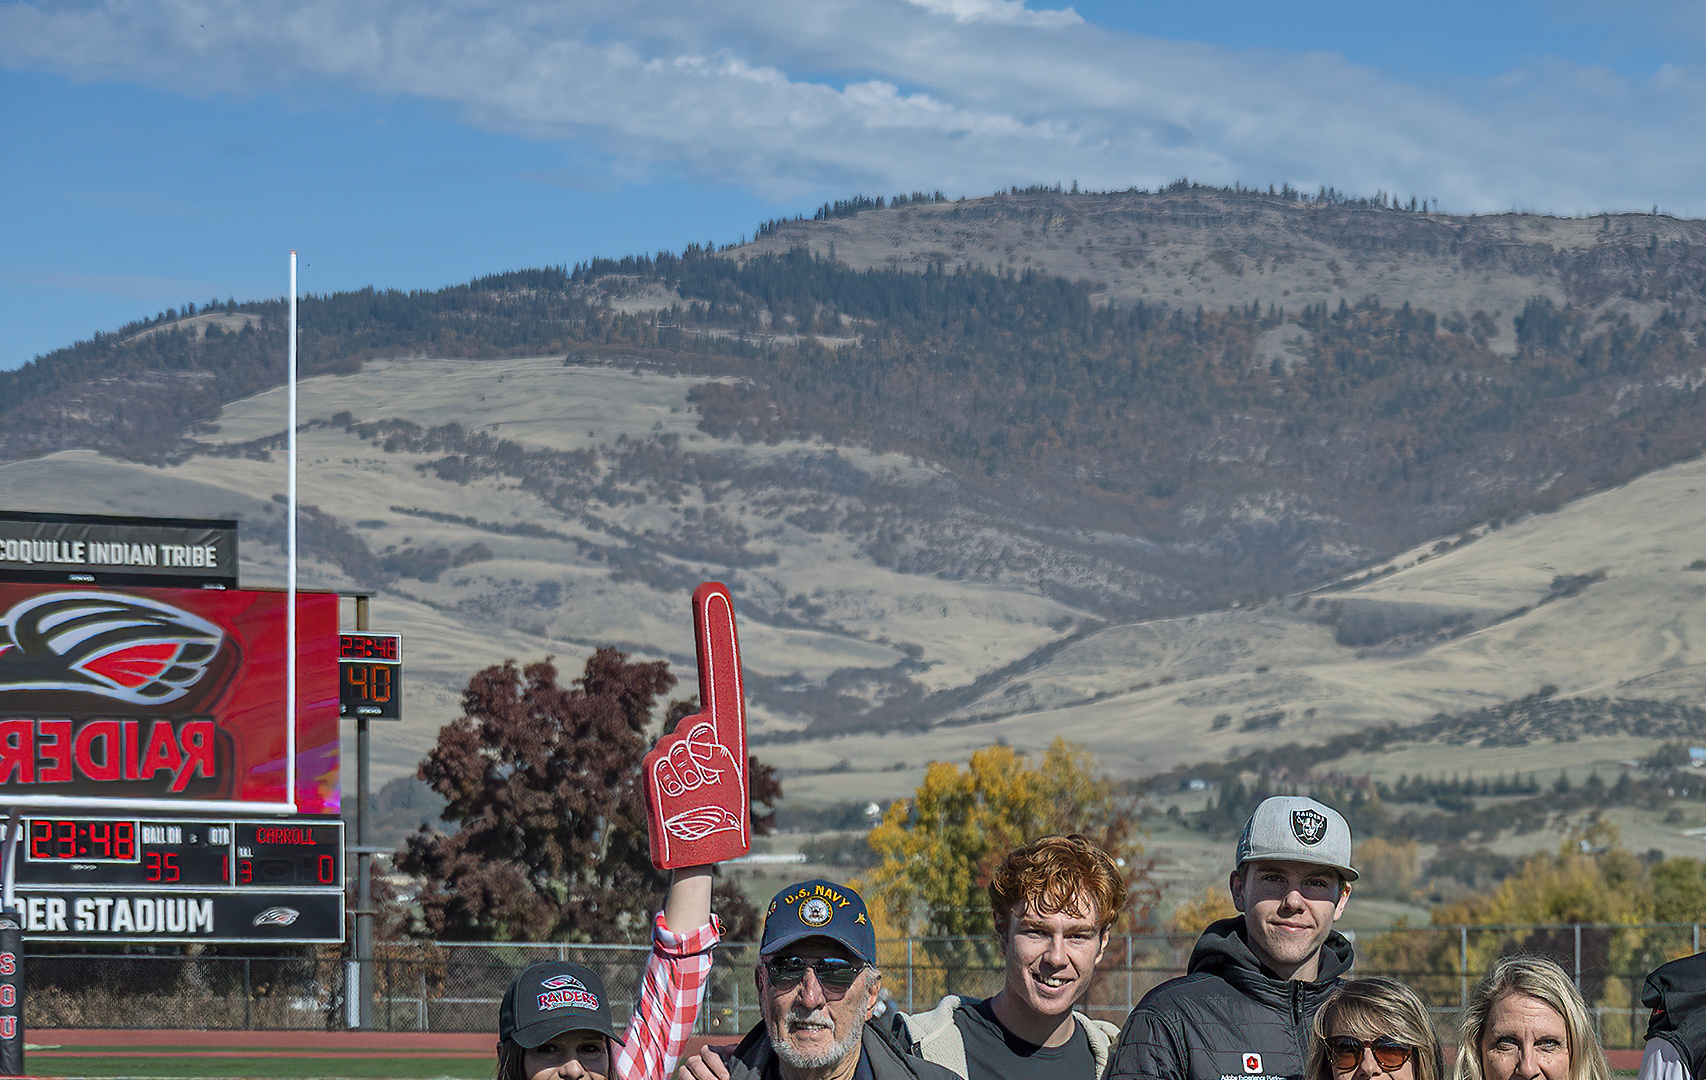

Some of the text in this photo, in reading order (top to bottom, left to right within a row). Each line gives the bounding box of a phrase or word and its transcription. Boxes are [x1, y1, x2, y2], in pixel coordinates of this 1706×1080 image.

[89, 542, 156, 567] INDIAN
[161, 545, 217, 569] TRIBE
[349, 665, 391, 702] 40
[32, 821, 134, 860] 23:48
[142, 825, 166, 844] BALL
[256, 827, 318, 845] CARROLL
[147, 852, 181, 882] 35
[222, 853, 229, 881] 1
[240, 860, 252, 883] 3
[317, 854, 334, 884] 0
[814, 885, 851, 908] NAVY
[74, 897, 214, 933] STADIUM
[537, 989, 600, 1011] RAIDERS
